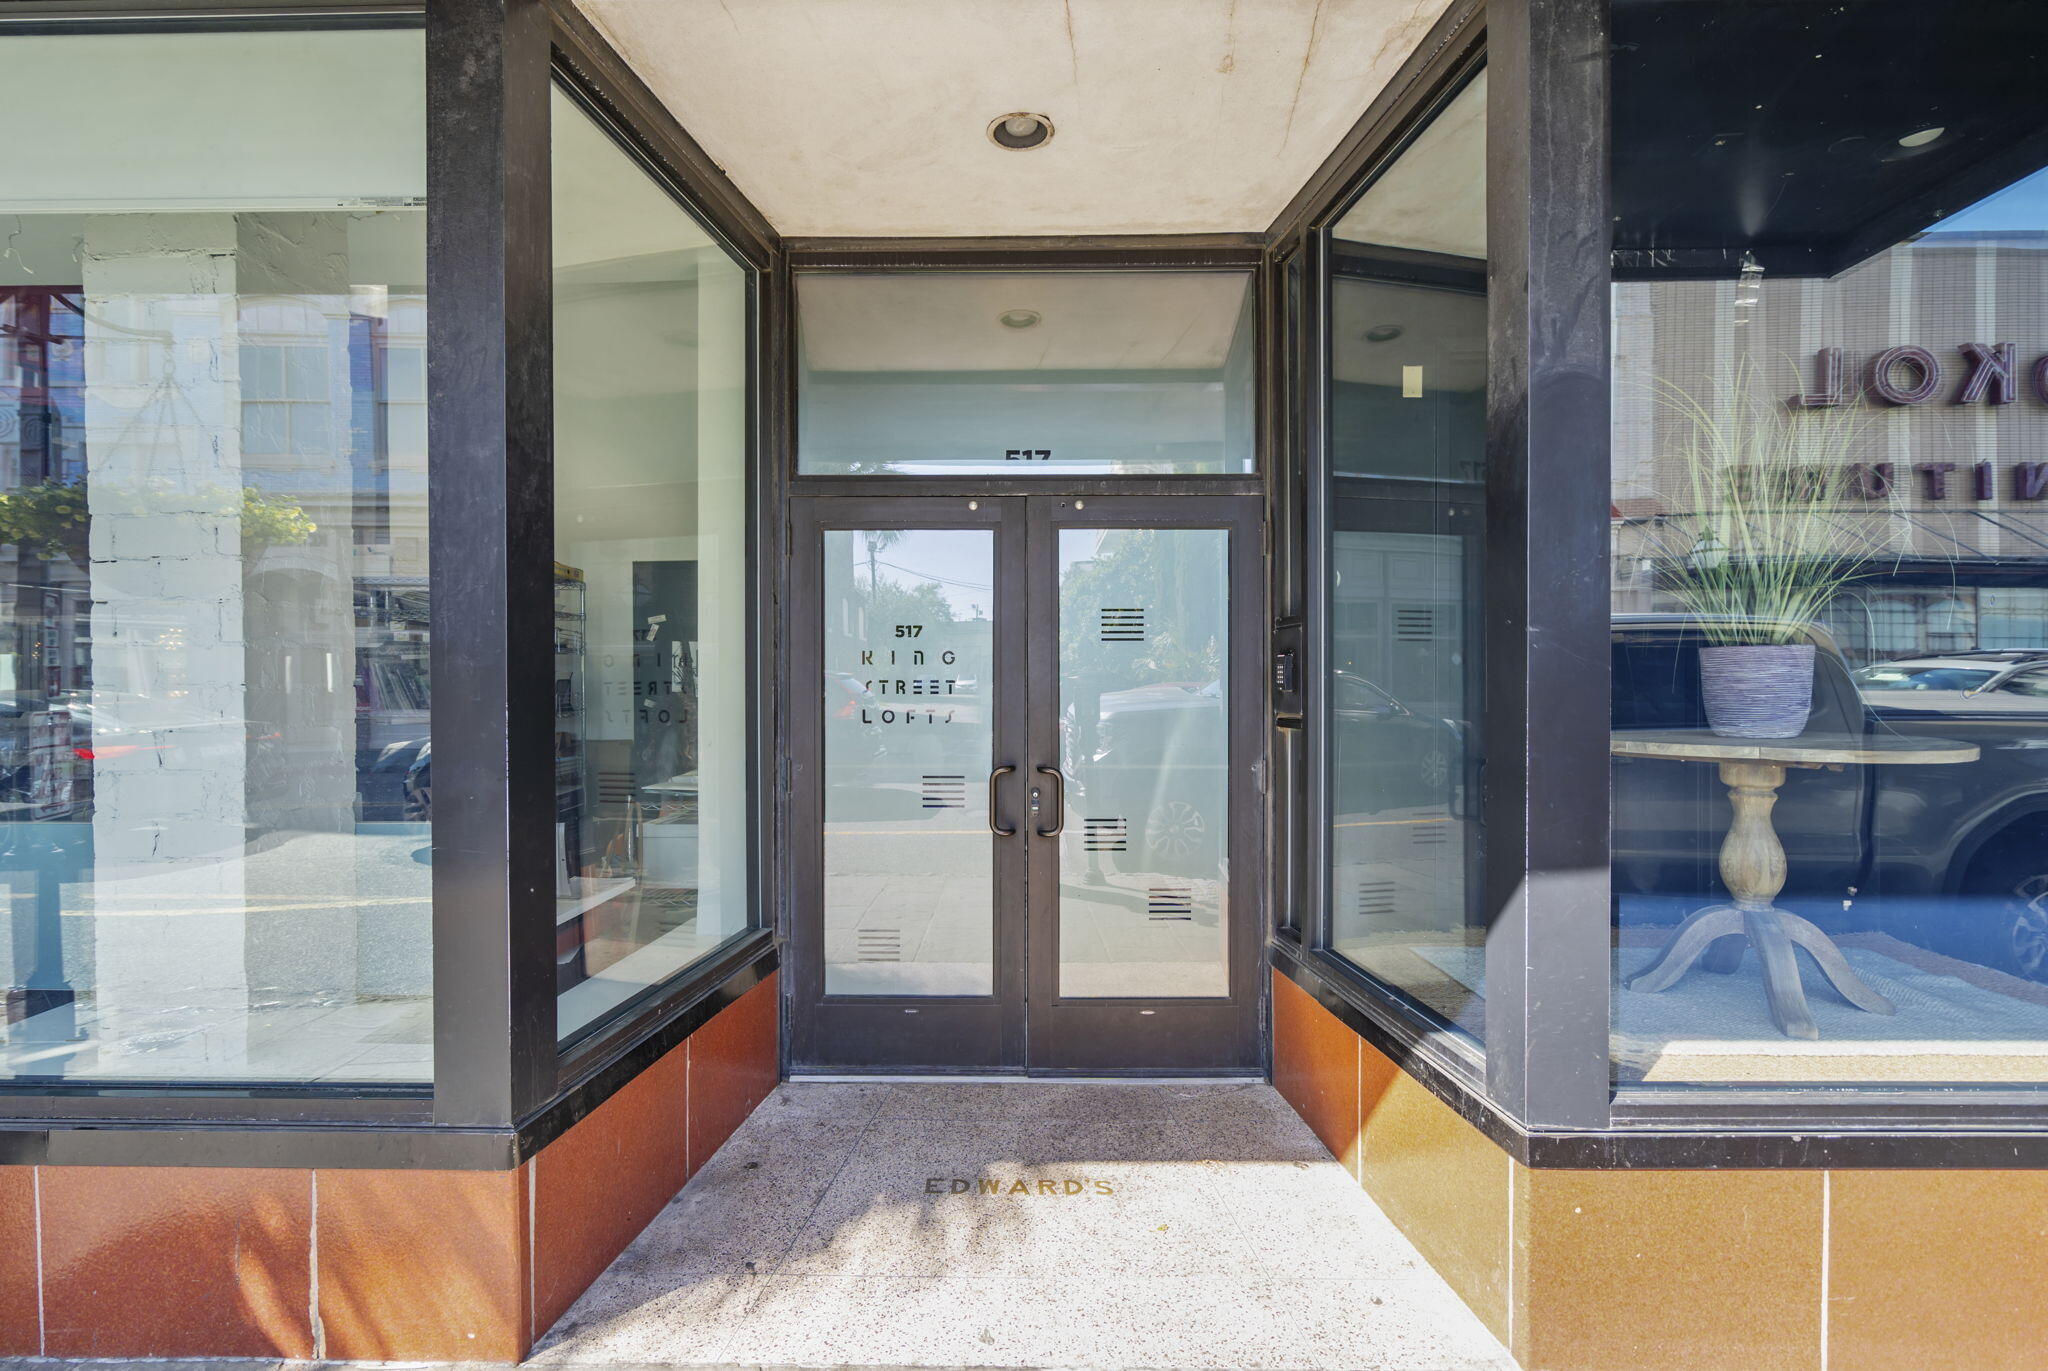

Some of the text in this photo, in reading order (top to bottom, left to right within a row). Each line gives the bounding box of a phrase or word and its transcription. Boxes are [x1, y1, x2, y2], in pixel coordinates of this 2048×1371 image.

[1006, 449, 1051, 461] 517
[895, 624, 923, 638] 517
[862, 650, 956, 665] KING
[864, 679, 956, 695] STREET
[862, 709, 955, 724] LOFTS
[924, 1177, 1115, 1196] EDWARD'S
